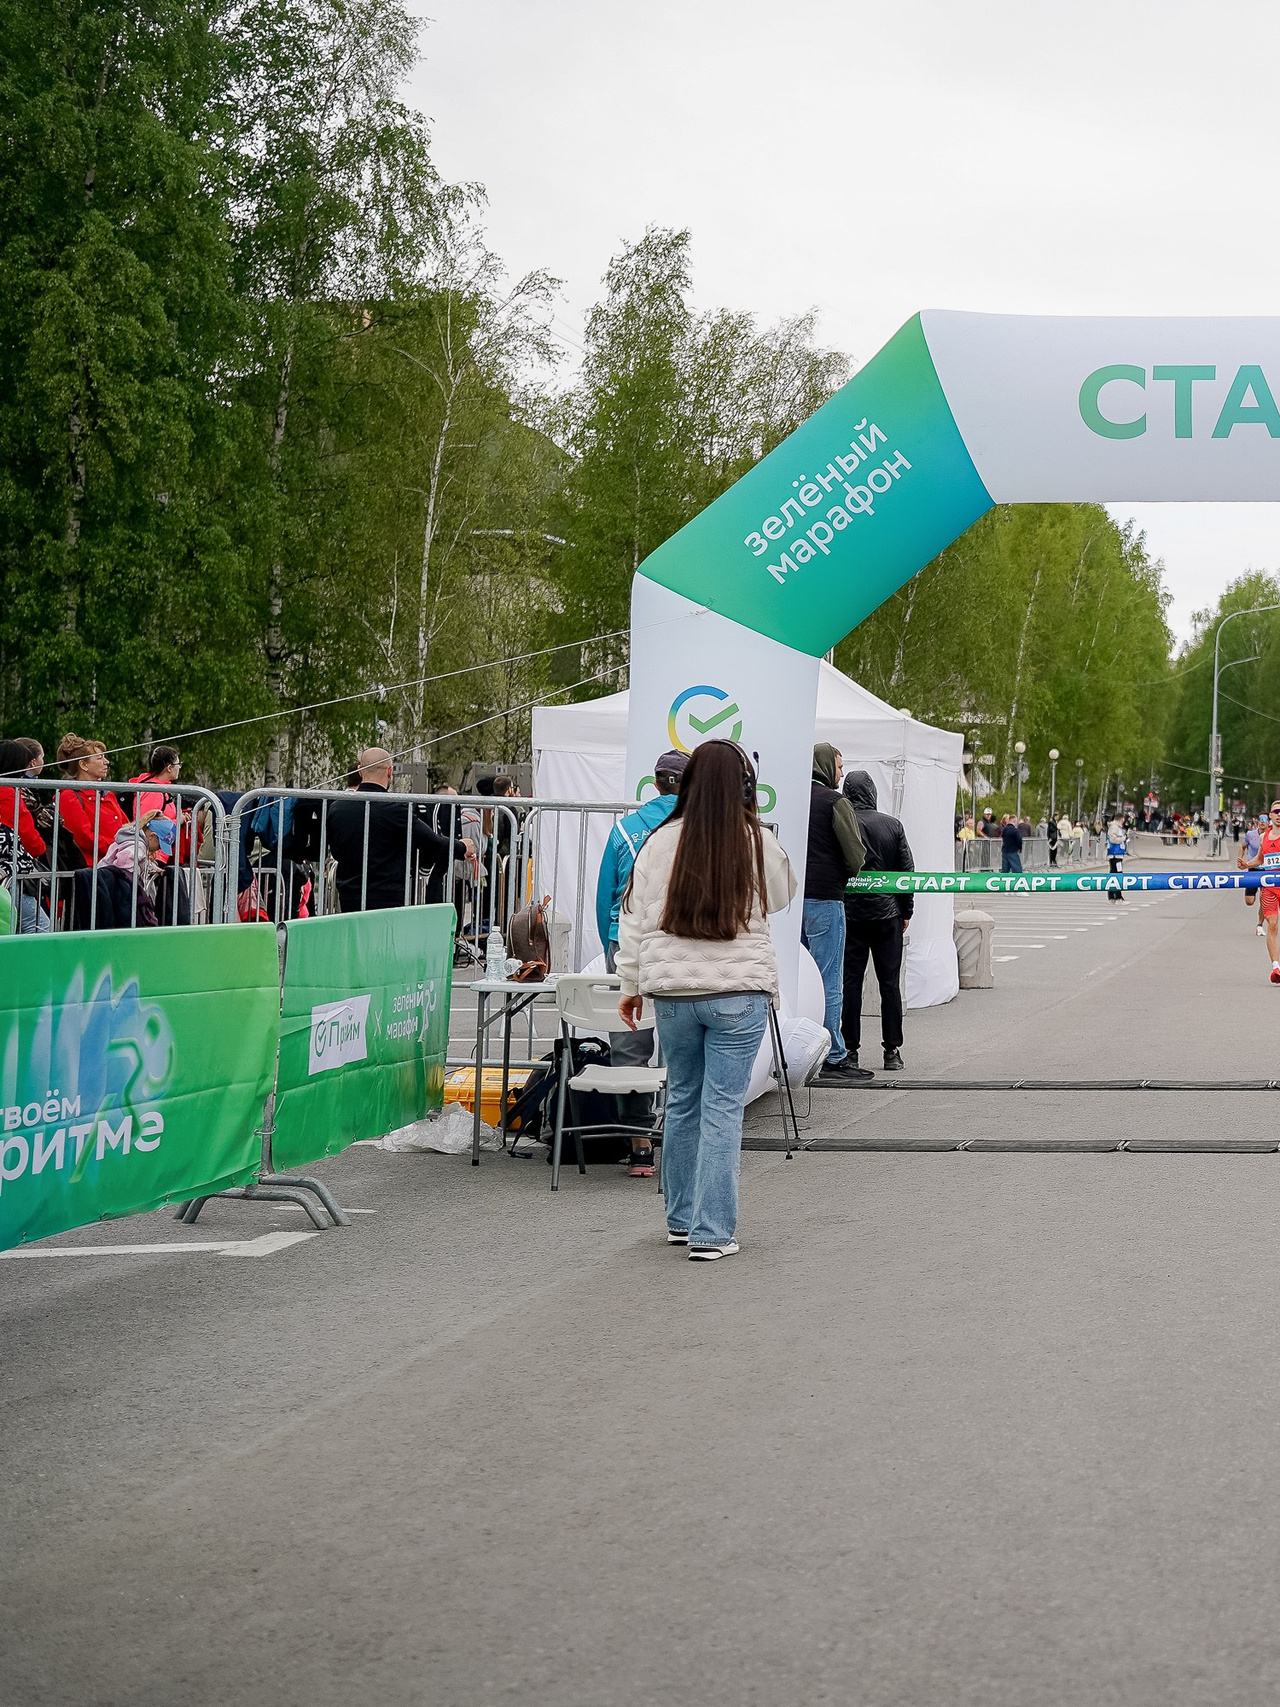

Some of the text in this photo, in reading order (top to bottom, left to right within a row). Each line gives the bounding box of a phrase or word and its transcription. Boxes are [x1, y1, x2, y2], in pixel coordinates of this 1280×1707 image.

[743, 417, 888, 557] зелёный
[766, 450, 913, 585] марафон
[895, 876, 971, 891] СТАРТ
[985, 876, 1061, 891] СТАРТ
[1076, 876, 1152, 890] СТАРТ
[1168, 874, 1244, 889] СТАРТ
[0, 1111, 165, 1196] ритме
